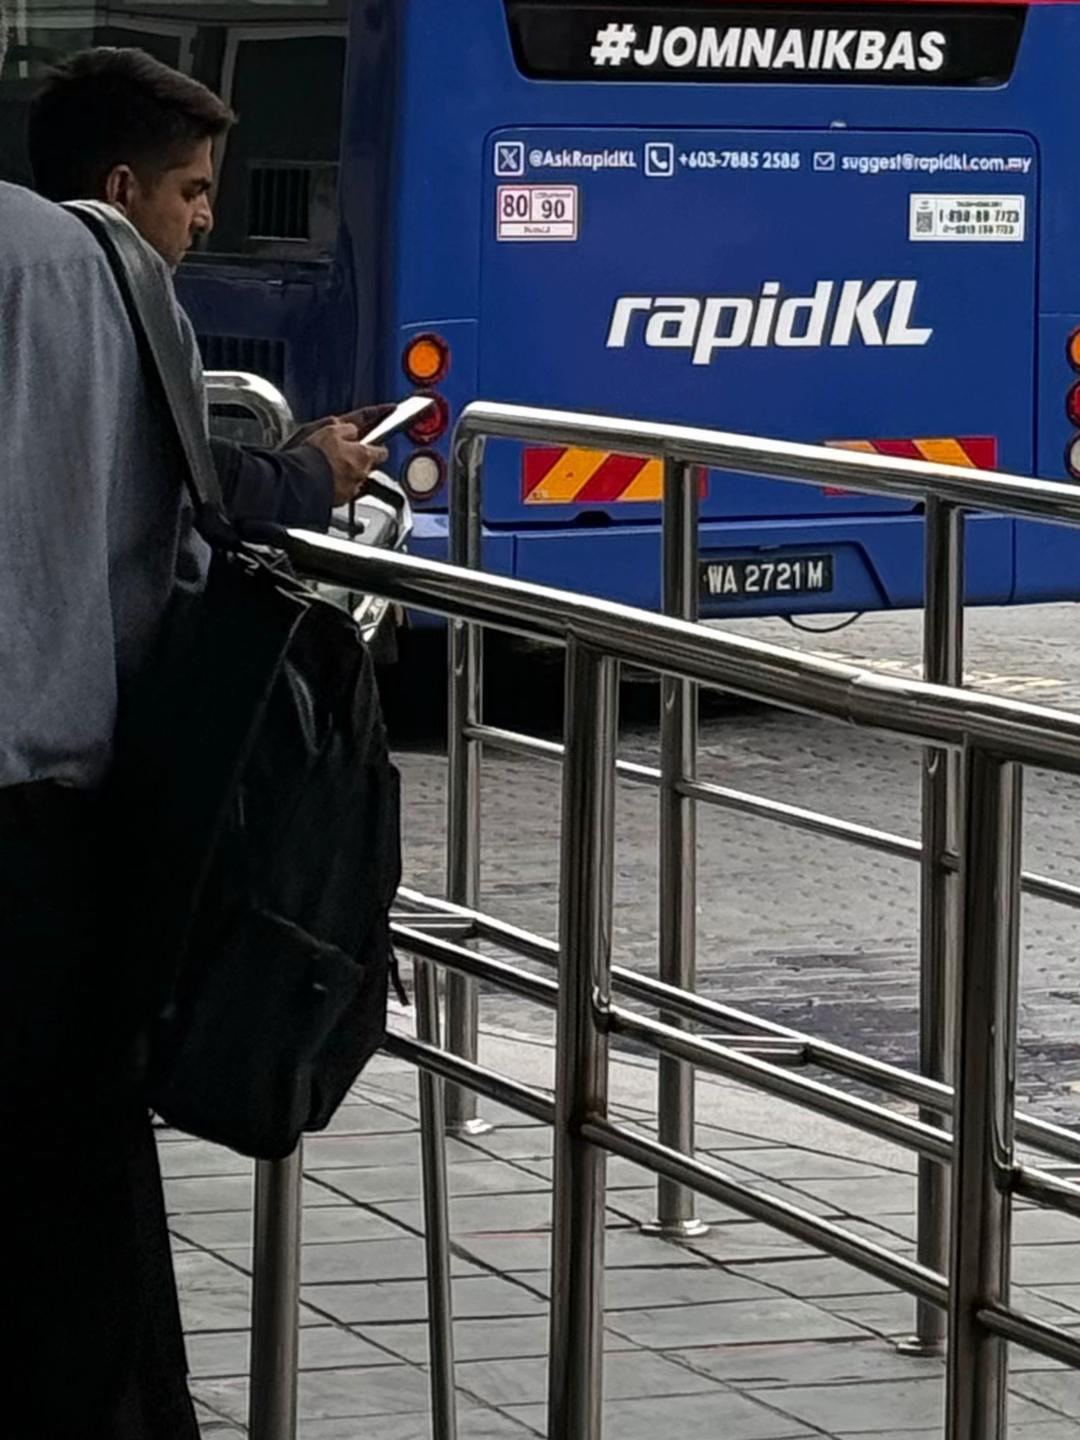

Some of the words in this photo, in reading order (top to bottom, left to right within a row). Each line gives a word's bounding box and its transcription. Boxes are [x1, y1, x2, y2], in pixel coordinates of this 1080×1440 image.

[590, 22, 947, 72] #JOMNAIKBAS
[529, 149, 637, 171] @AskRapidKL
[502, 193, 529, 218] 80
[541, 198, 566, 220] 90
[606, 279, 934, 365] rapidKL
[708, 564, 738, 594] WA
[744, 562, 801, 593] 2721
[807, 560, 823, 589] M
